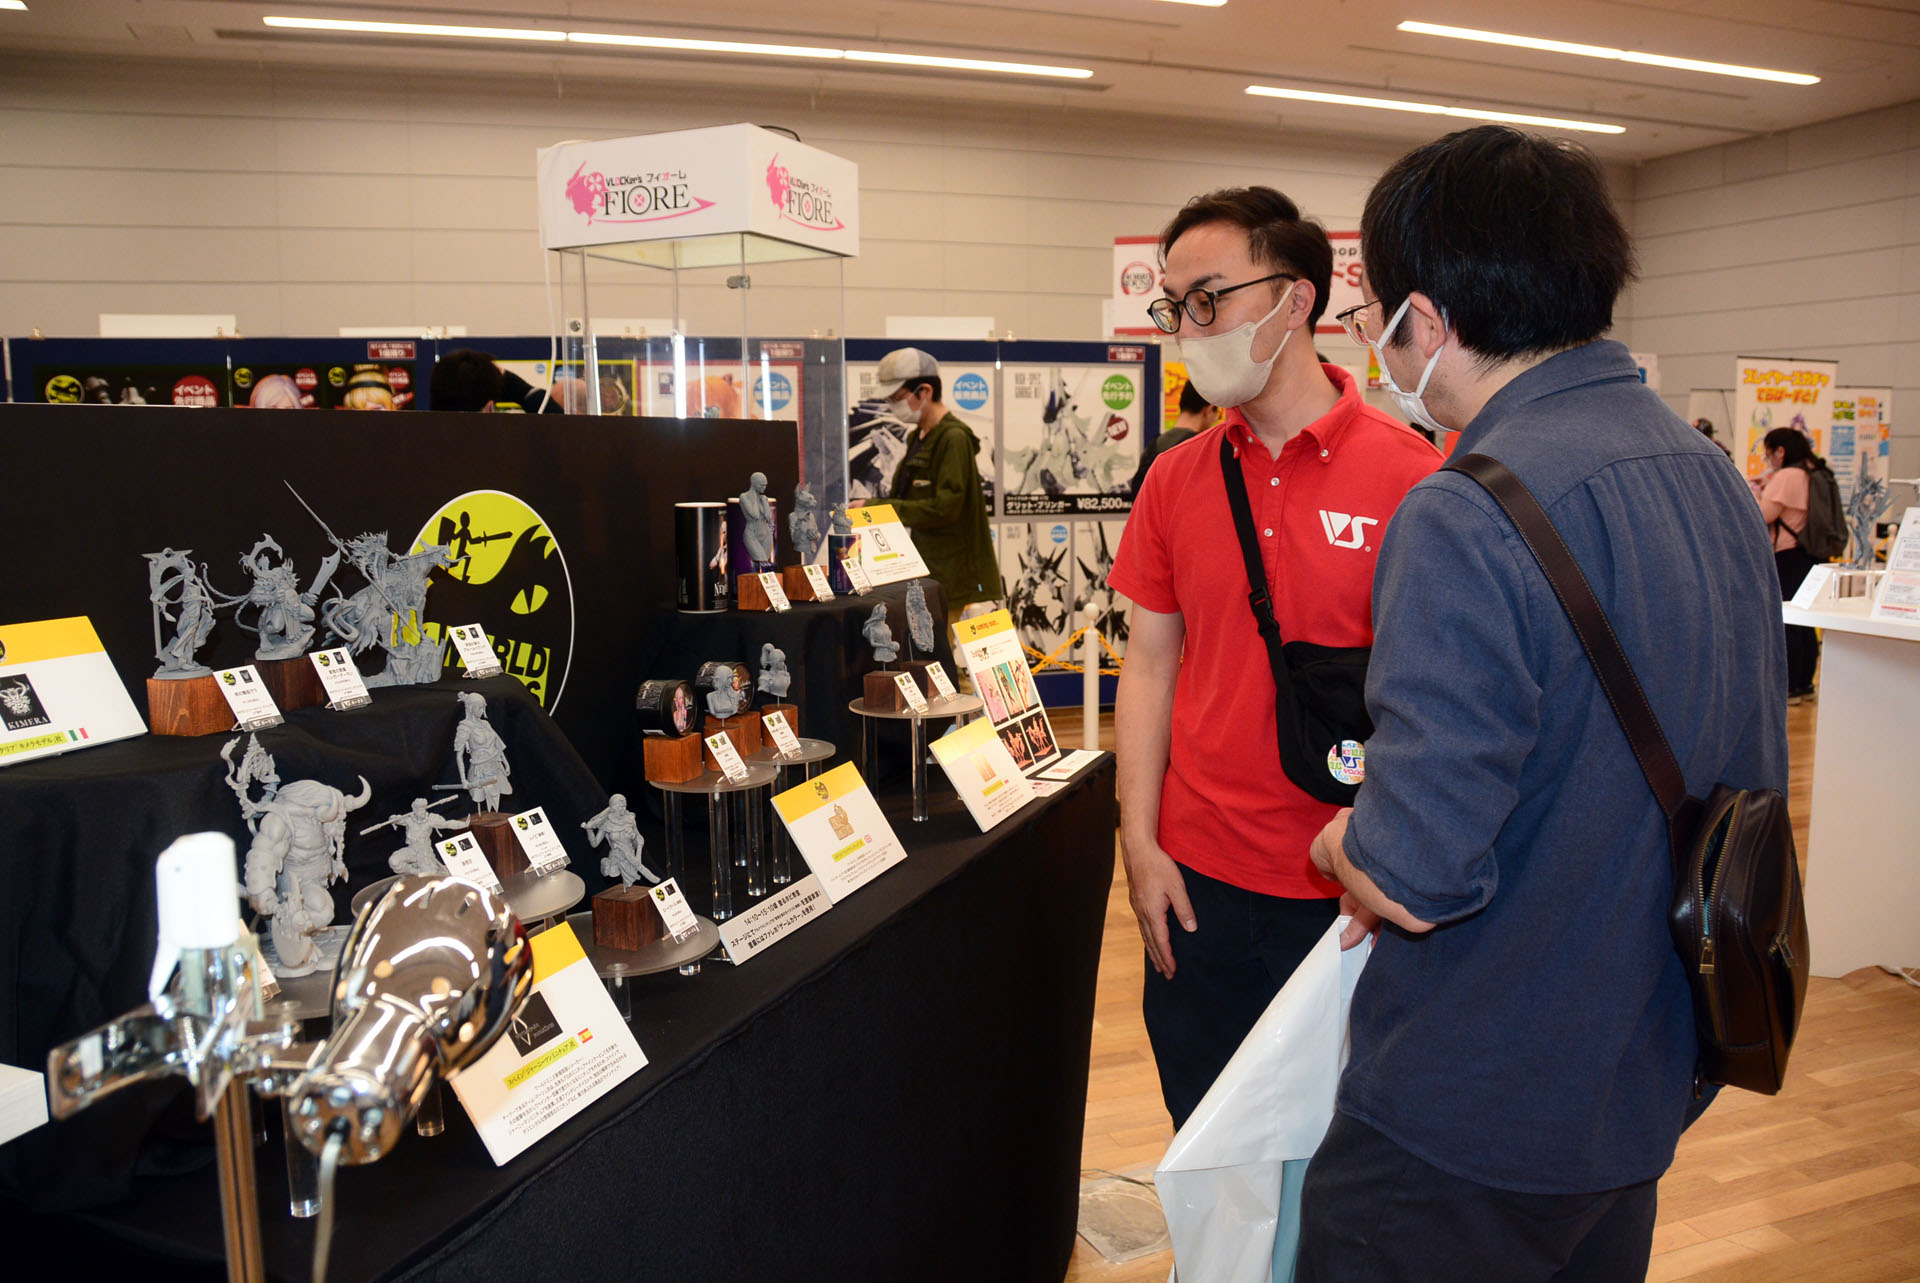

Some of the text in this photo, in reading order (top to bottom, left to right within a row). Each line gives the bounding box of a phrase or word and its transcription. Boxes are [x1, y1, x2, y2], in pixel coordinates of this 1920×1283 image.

[604, 184, 691, 216] FIORE
[788, 190, 834, 225] FIORE
[174, 384, 215, 396] イベント
[1076, 497, 1123, 511] ¥82,500
[7, 716, 49, 731] KIMERA
